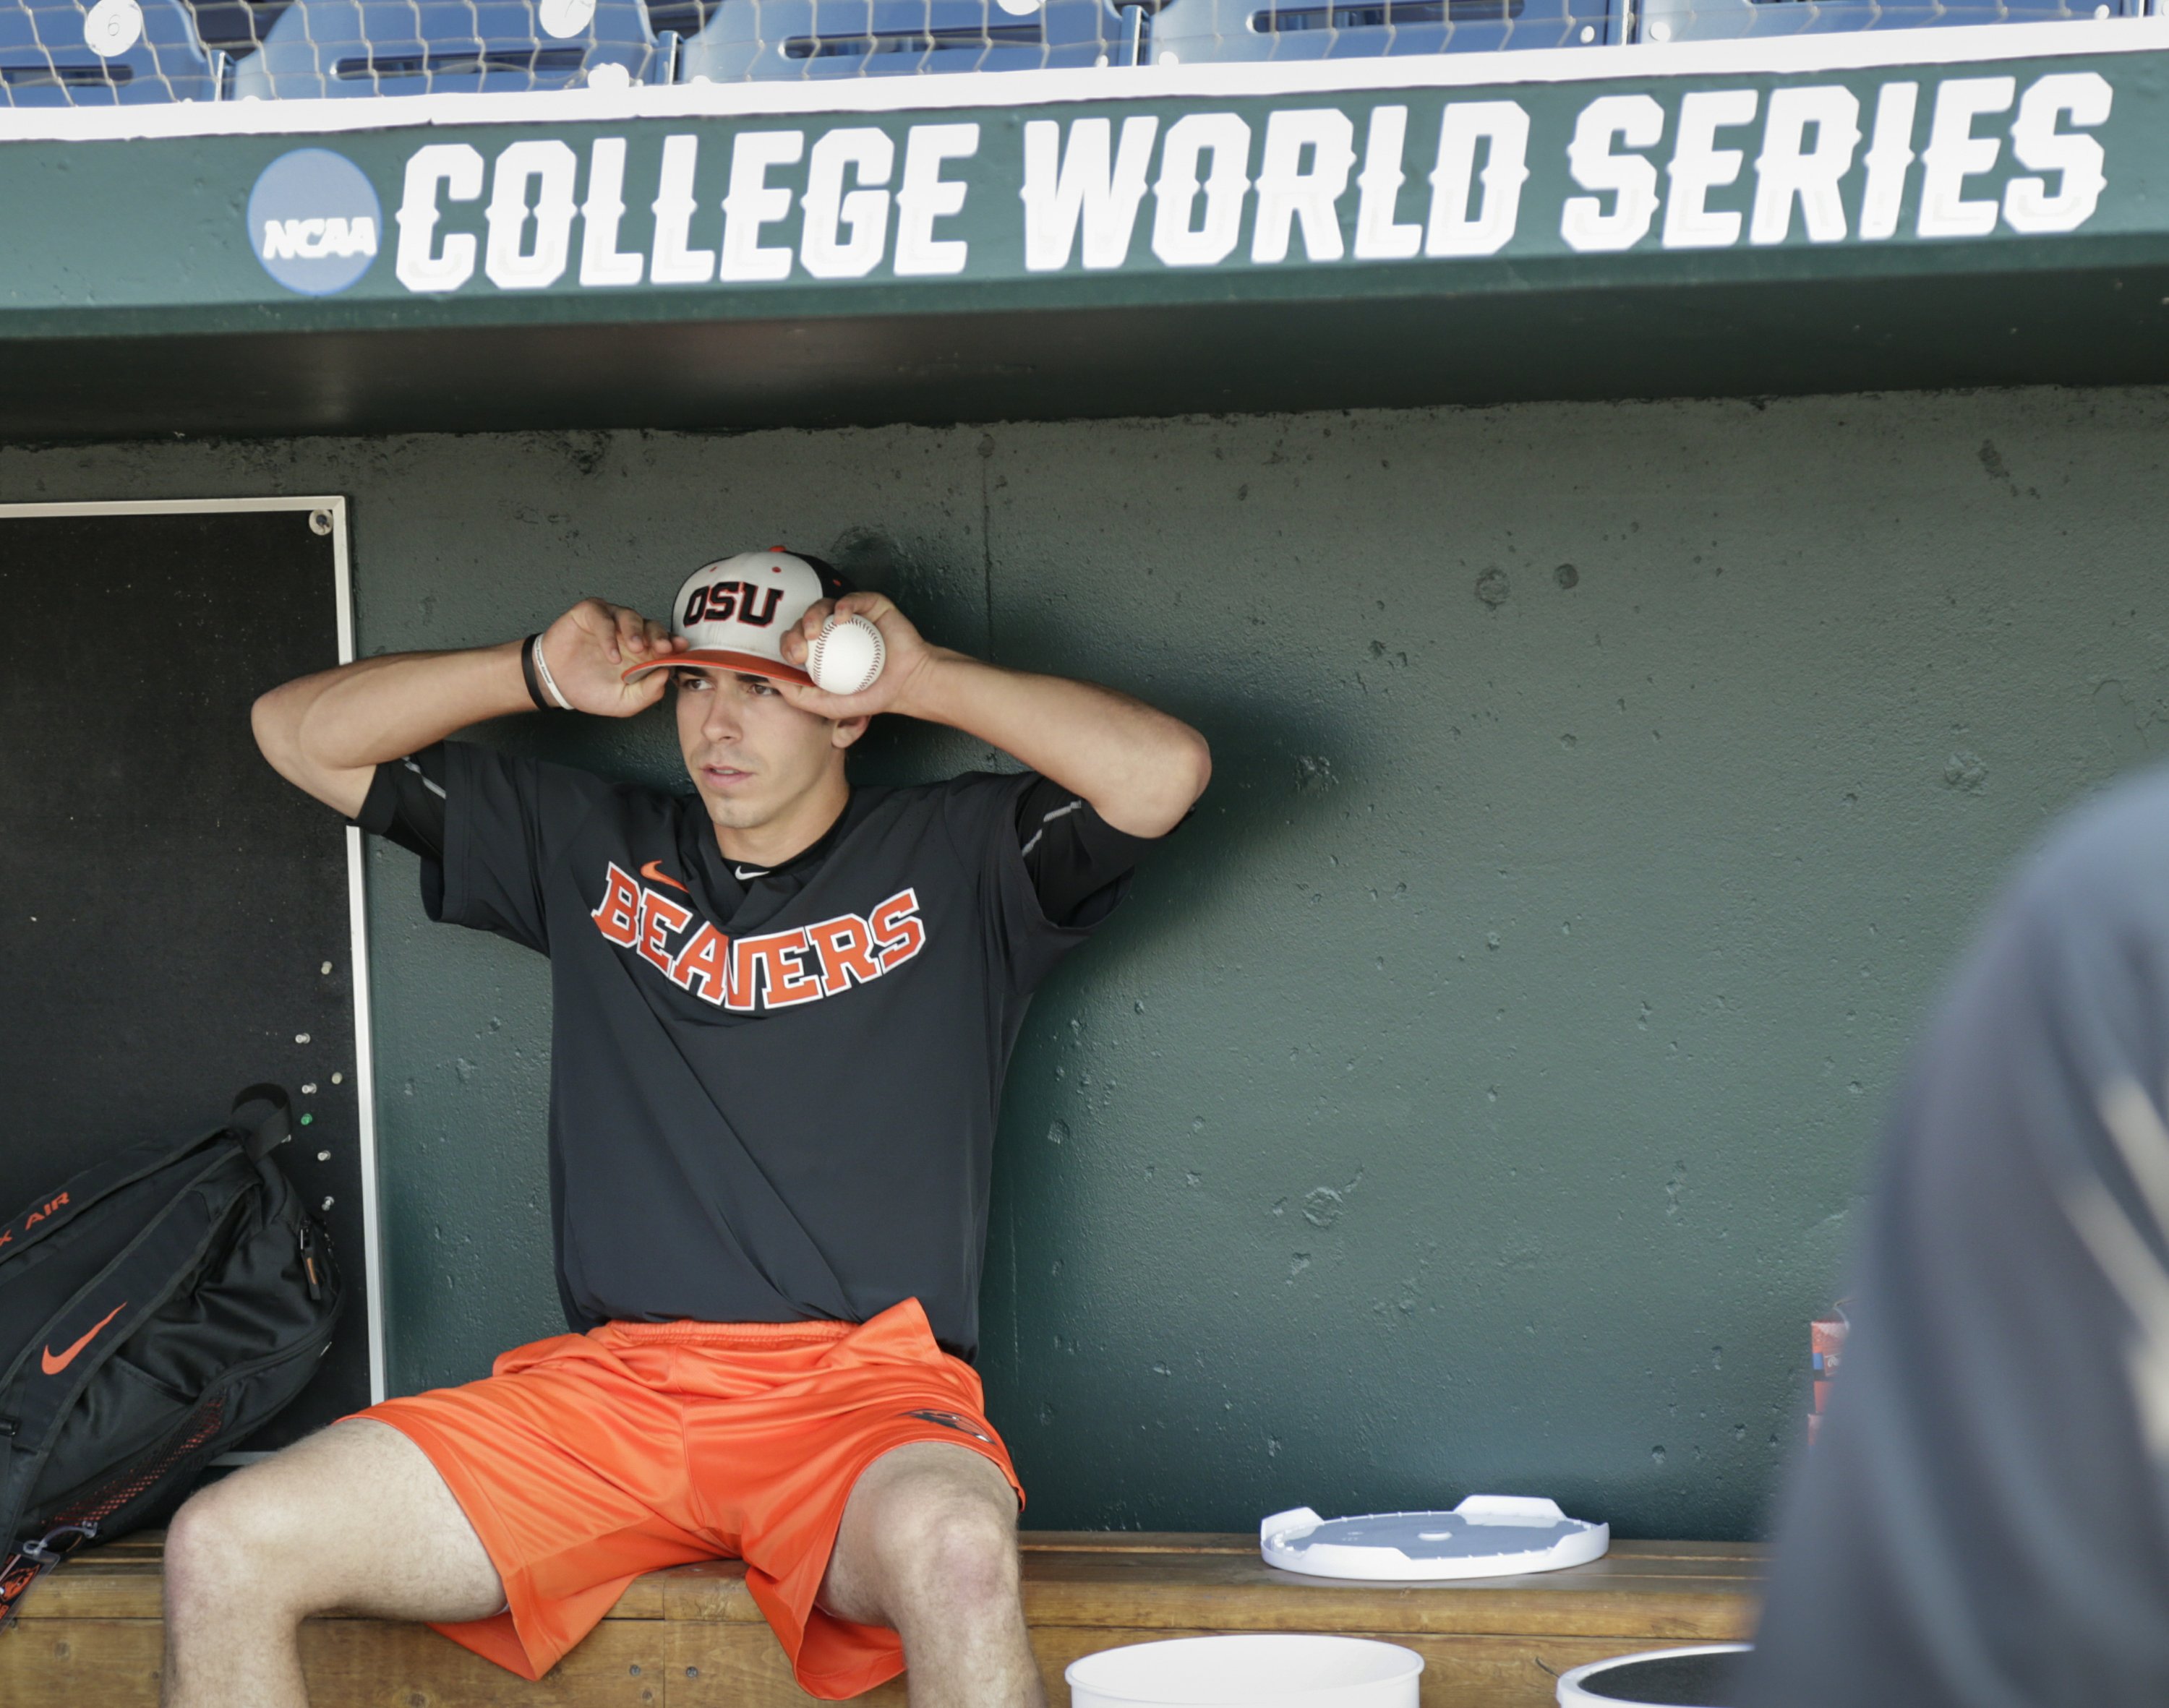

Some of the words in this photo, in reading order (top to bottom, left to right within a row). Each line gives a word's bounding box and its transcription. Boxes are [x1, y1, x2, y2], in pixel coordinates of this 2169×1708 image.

[108, 14, 121, 37] 6
[395, 121, 980, 292] COLLEGE
[1021, 100, 1531, 272] WORLD
[1560, 72, 2113, 254] SERIES
[262, 216, 377, 260] NCAA
[683, 581, 784, 628] OSU
[591, 861, 925, 1011] BEAVERS
[25, 1191, 70, 1231] AIR
